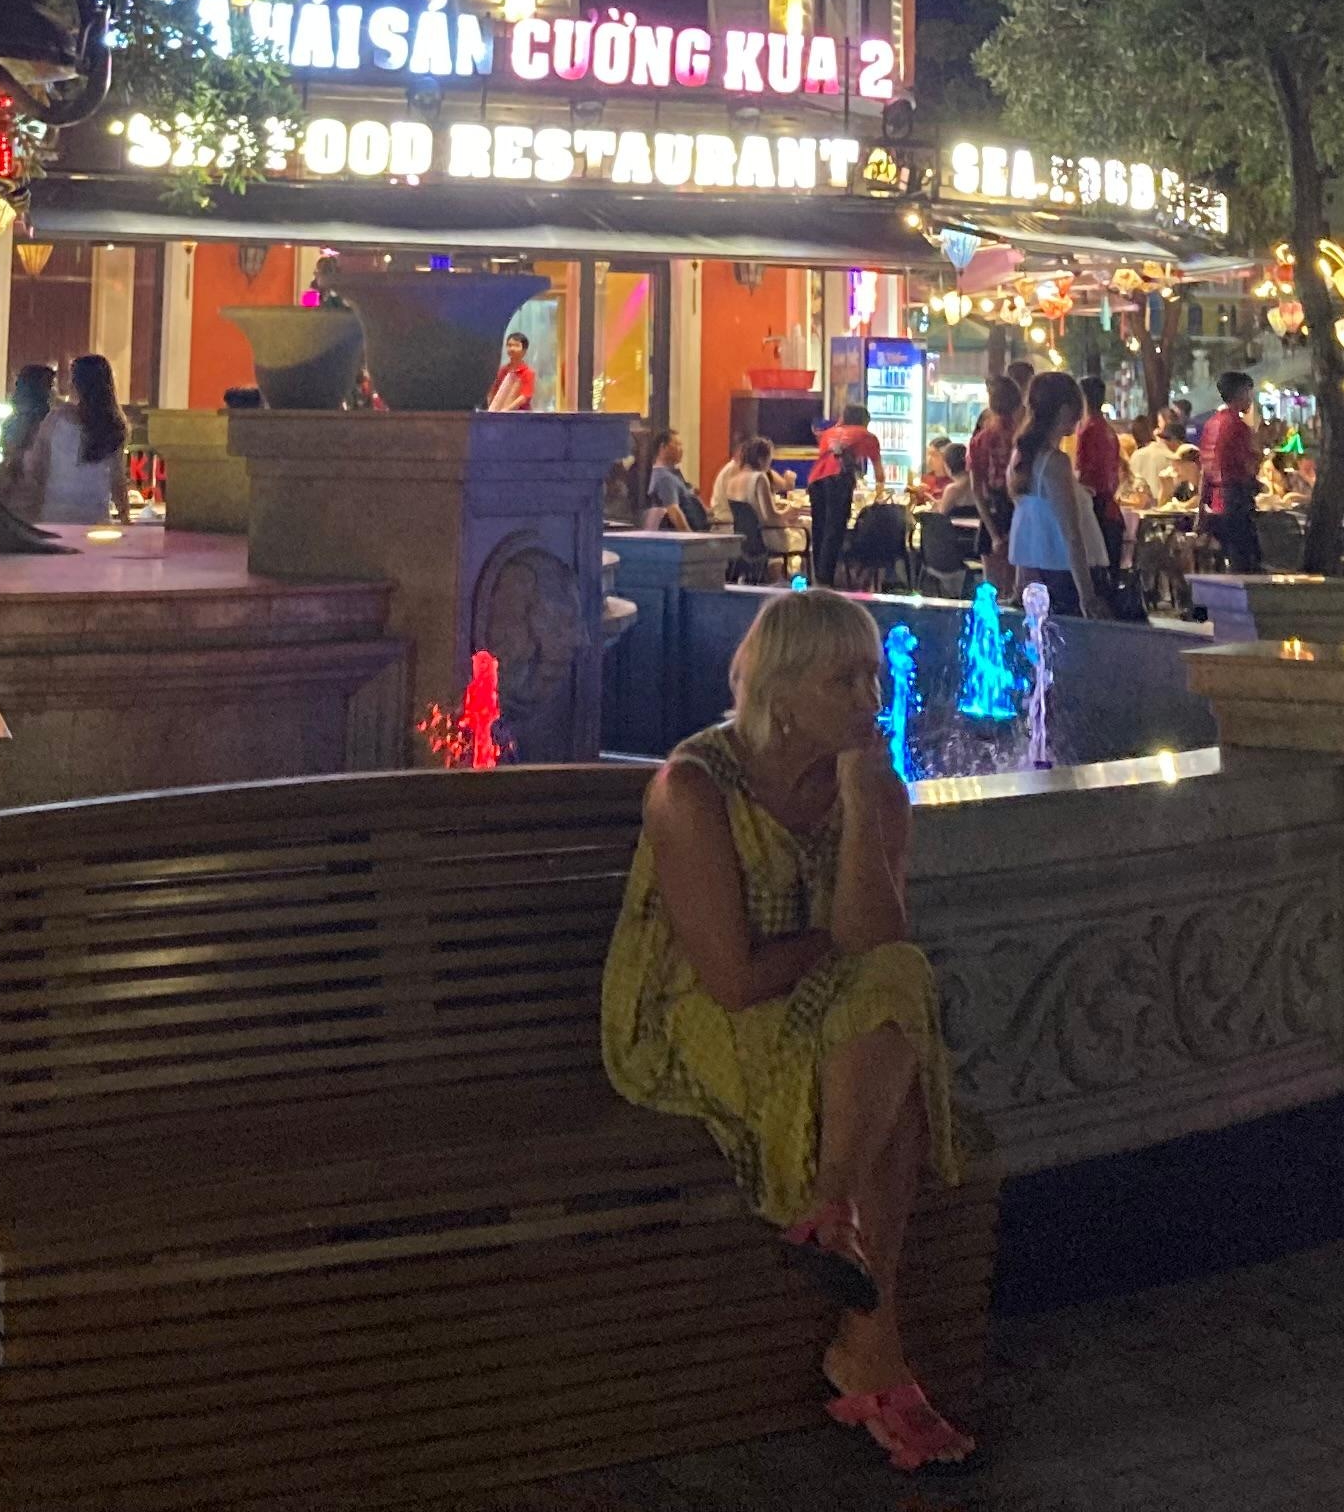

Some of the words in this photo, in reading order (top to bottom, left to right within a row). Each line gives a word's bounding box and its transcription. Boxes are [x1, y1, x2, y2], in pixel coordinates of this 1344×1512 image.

[511, 7, 711, 87] CƯỜNG
[723, 30, 840, 95] KUA
[858, 39, 895, 99] 2
[449, 124, 859, 188] RESTAURANT
